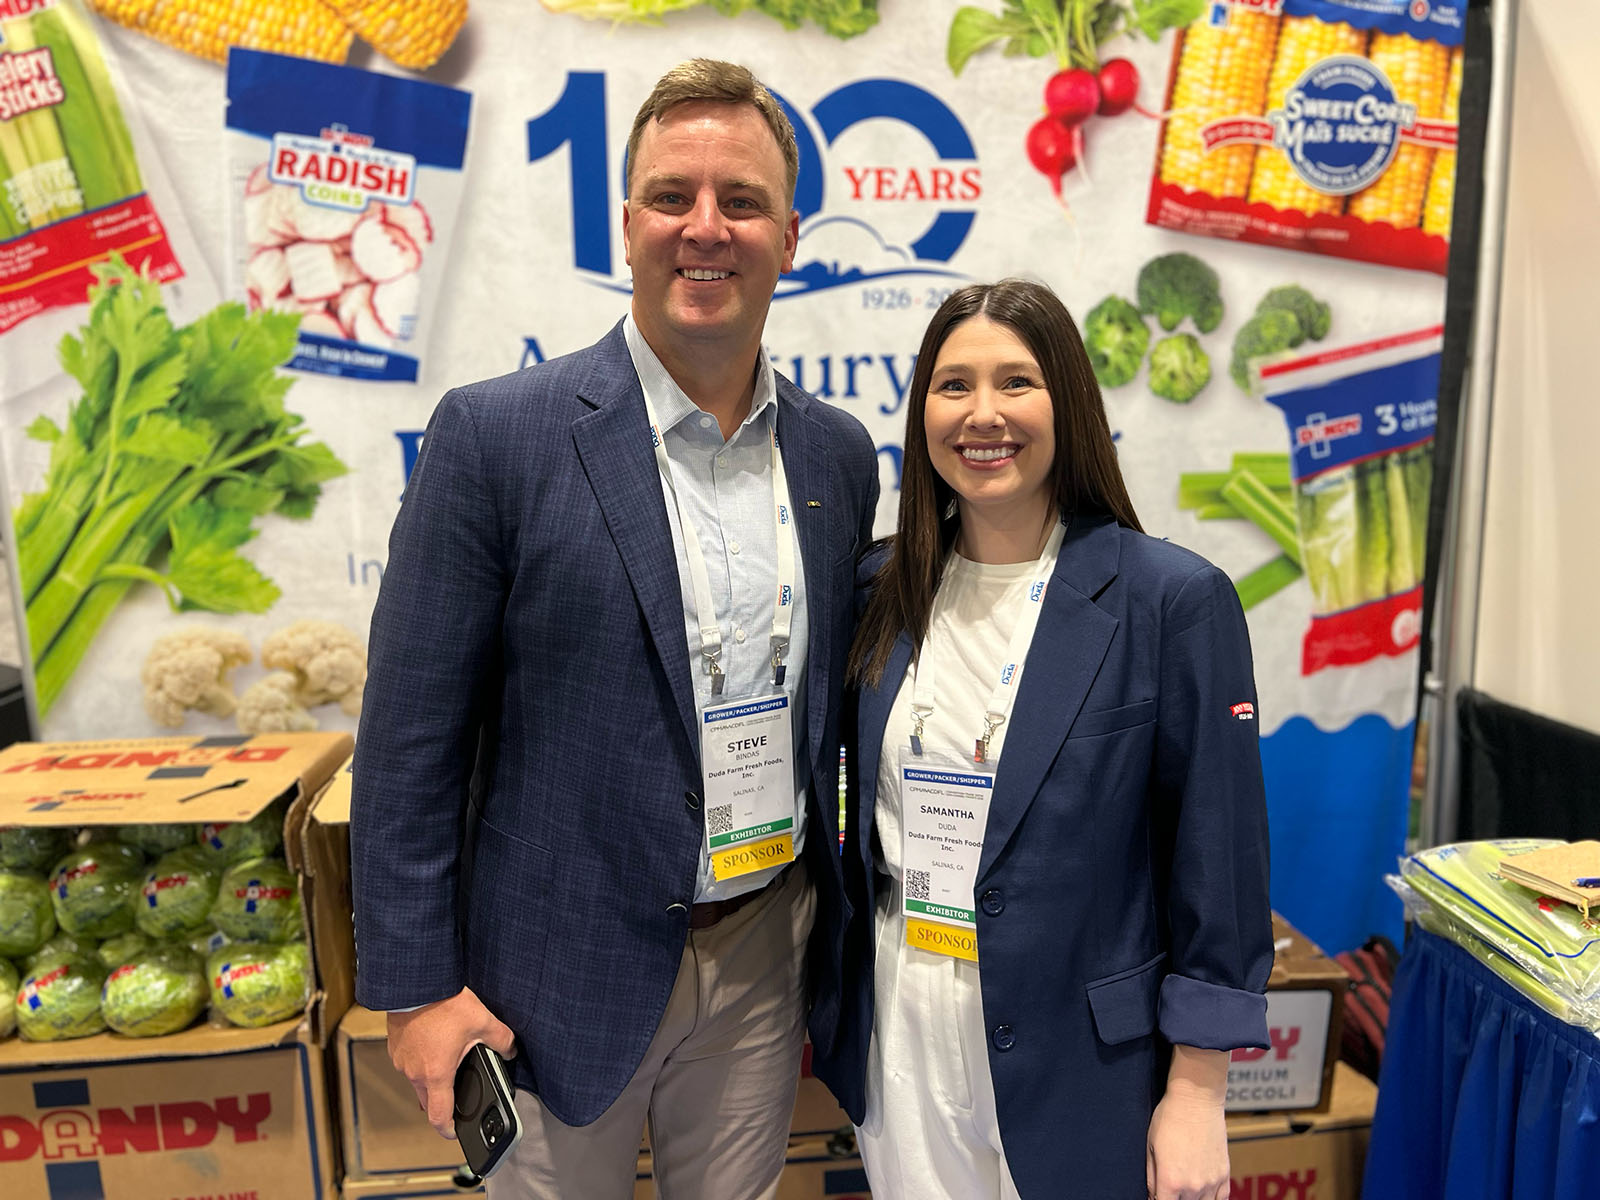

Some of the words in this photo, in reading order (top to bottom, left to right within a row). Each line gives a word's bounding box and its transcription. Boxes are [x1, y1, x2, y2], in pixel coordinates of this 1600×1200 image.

[276, 149, 408, 197] RADISH
[844, 167, 983, 201] YEARS
[306, 184, 364, 207] COINS
[862, 288, 912, 310] 1926
[925, 288, 956, 310] 20
[1374, 403, 1399, 436] 3
[782, 584, 793, 607] Duda
[1031, 581, 1046, 603] Duda
[1001, 663, 1016, 685] Duda
[708, 700, 784, 720] GROWER/PACKER/SHIPPER
[727, 735, 768, 753] STEVE
[735, 750, 761, 761] BINDAS
[708, 770, 726, 779] Duda
[727, 766, 745, 775] Farm
[744, 762, 763, 771] Fresh
[763, 757, 785, 767] Foods,
[907, 771, 987, 786] GROWER/PACKER/SHIPPER
[920, 804, 975, 820] SAMANTHA
[730, 825, 773, 842] EXHIBITOR
[938, 822, 957, 832] DUDA
[908, 831, 925, 840] Duda
[926, 834, 943, 843] Farm
[944, 836, 963, 846] Fresh
[941, 844, 955, 853] Inc.
[723, 842, 785, 869] SPONSOR
[931, 860, 956, 871] SALINAS,
[925, 904, 970, 921] EXHIBITOR
[1228, 1069, 1288, 1084] EMIUM
[1226, 1087, 1296, 1101] OCCOLI
[0, 1092, 272, 1163] DANDY
[1229, 1169, 1317, 1200] NDY
